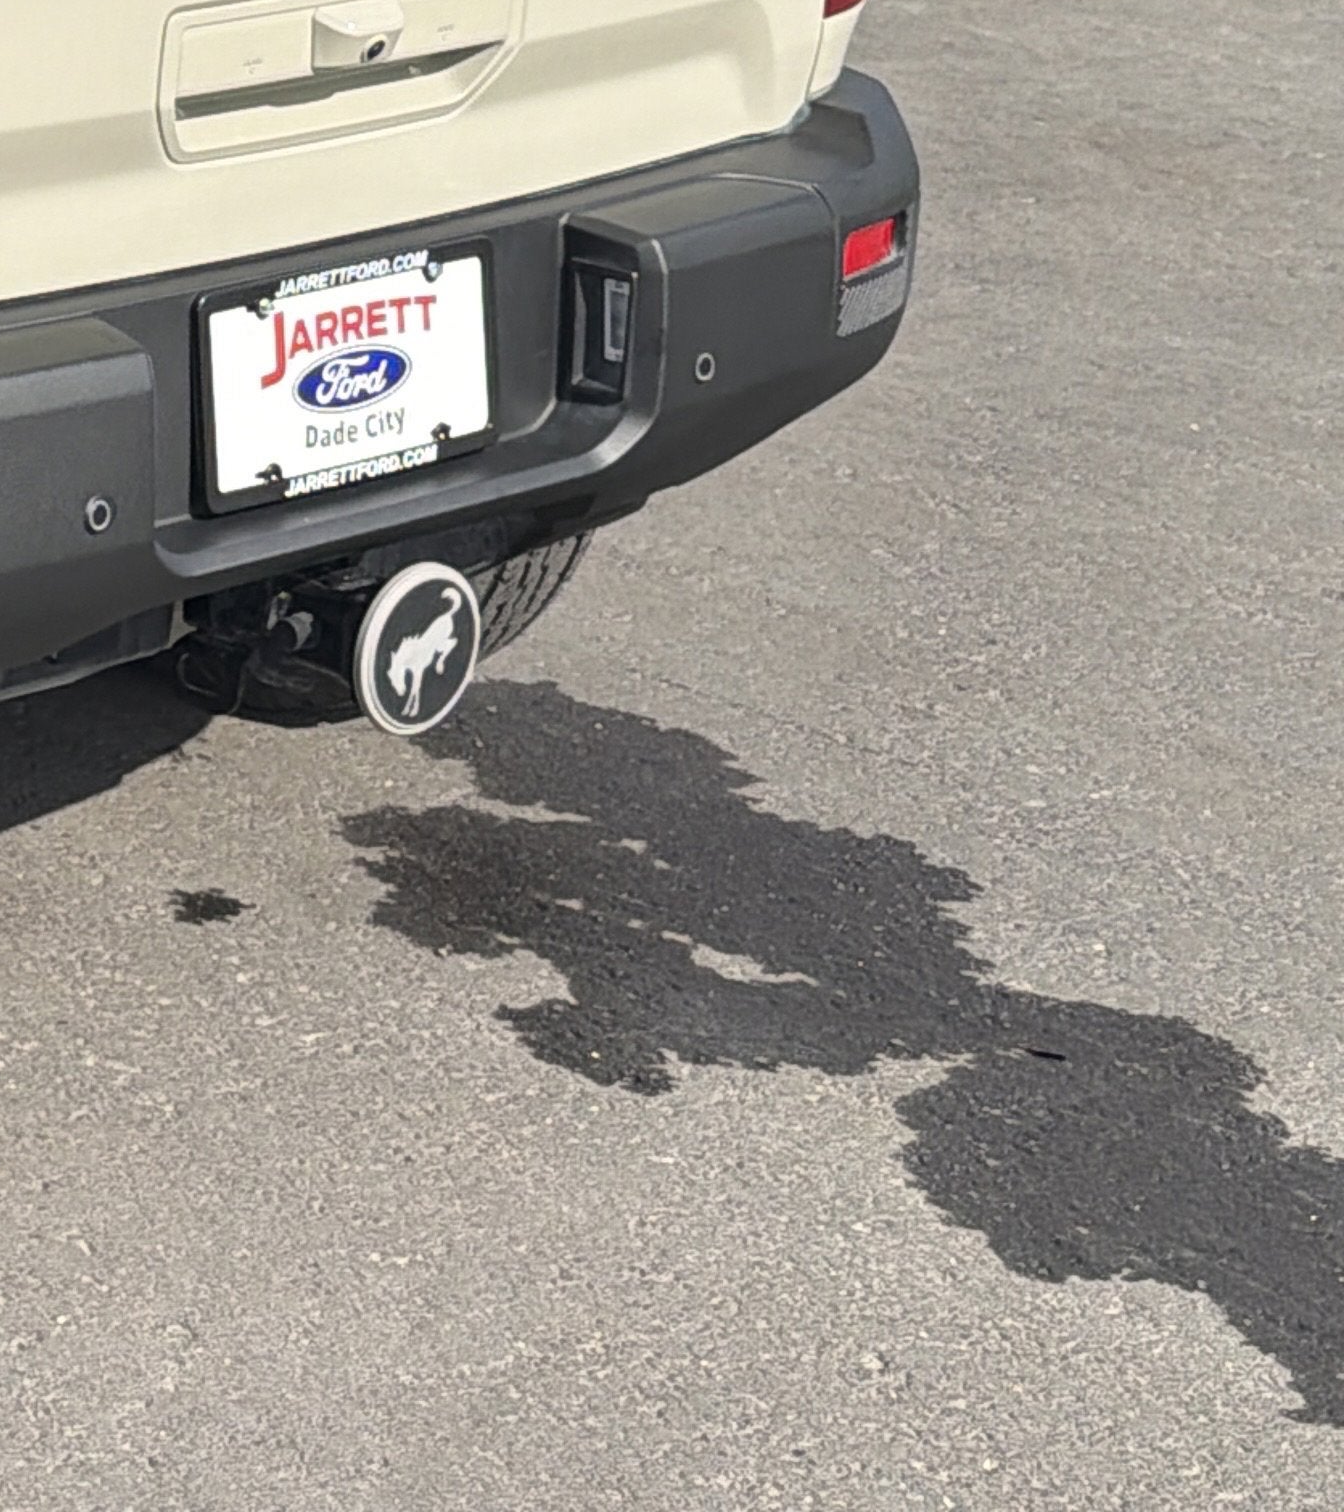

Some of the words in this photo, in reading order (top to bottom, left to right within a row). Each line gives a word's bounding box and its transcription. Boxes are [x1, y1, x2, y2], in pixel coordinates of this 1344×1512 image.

[274, 249, 429, 298] JARRETTFORD.COM
[260, 294, 437, 390] JARRETT
[315, 354, 388, 405] Ford
[305, 420, 359, 449] Dade
[365, 407, 406, 438] City
[284, 443, 438, 499] JARRETTFORD.COM
